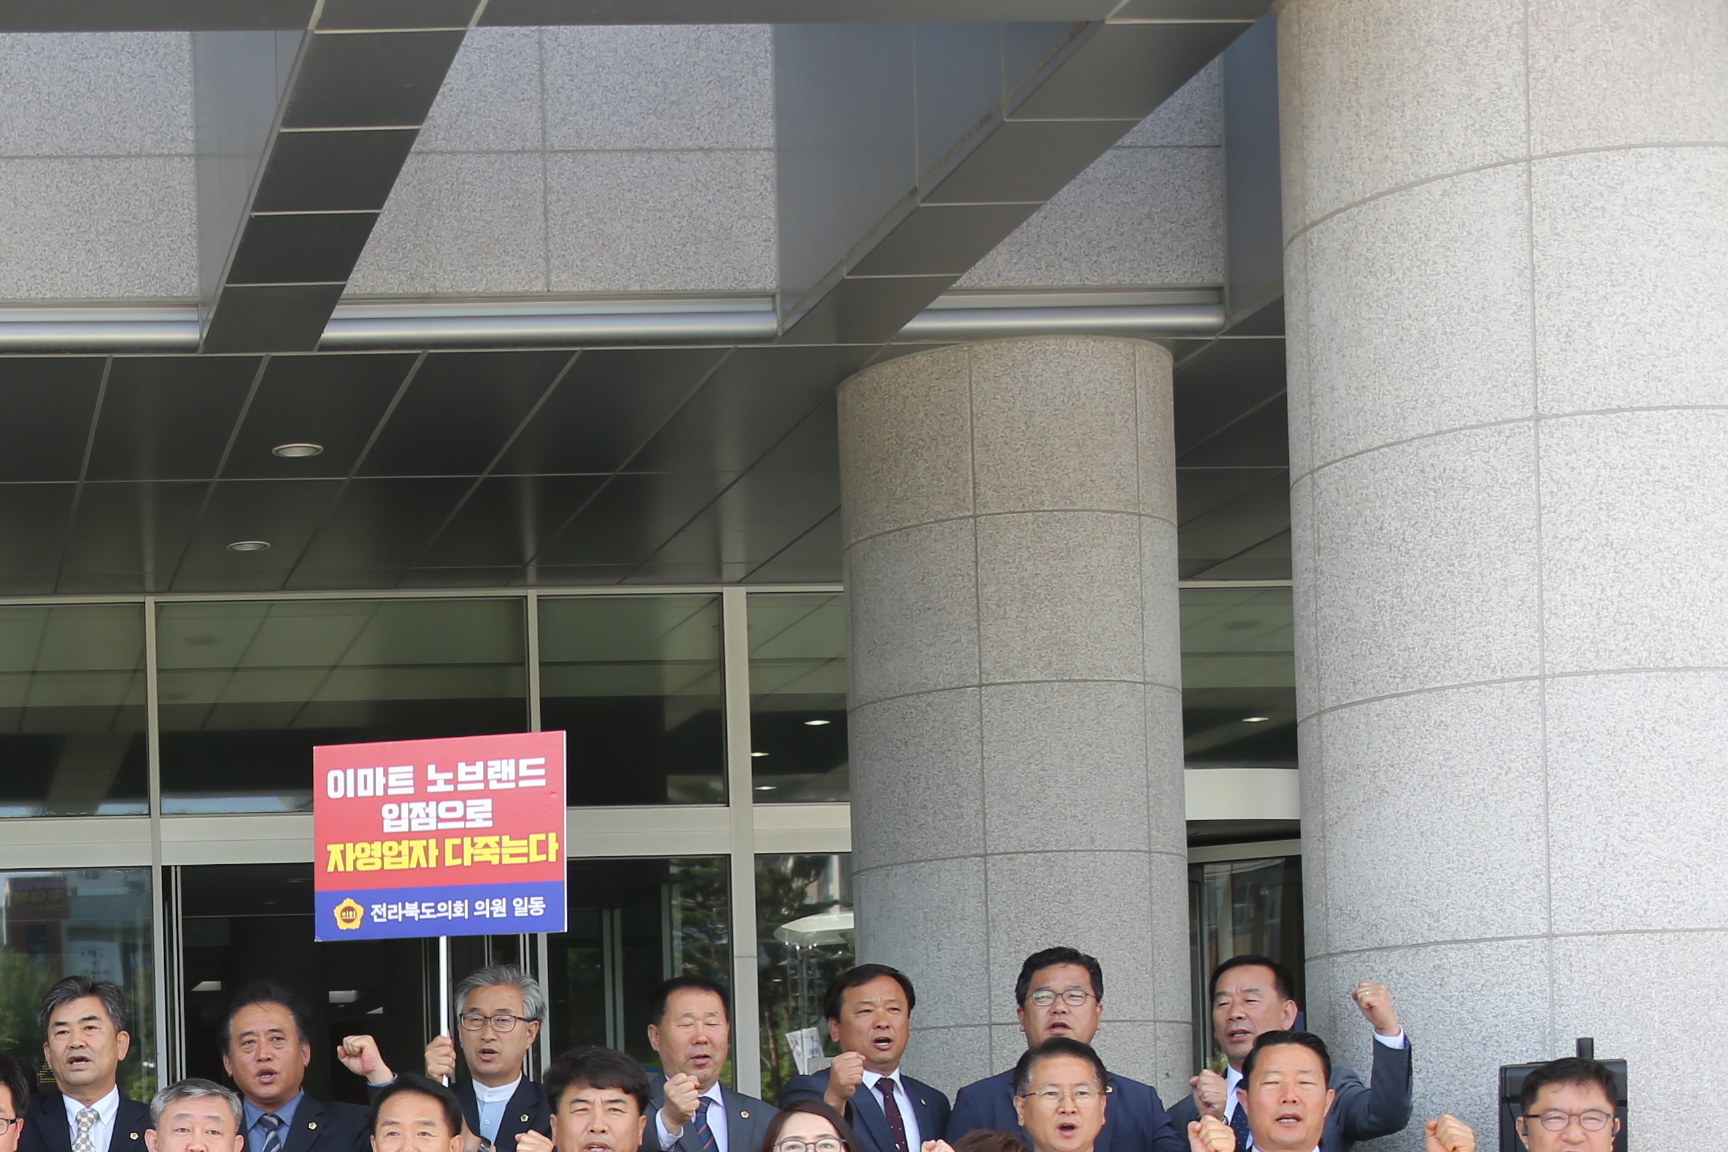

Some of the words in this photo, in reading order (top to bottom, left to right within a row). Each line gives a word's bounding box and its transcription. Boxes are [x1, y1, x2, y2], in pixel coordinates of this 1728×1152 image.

[326, 765, 415, 799] 이마트
[426, 757, 546, 793] 노브랜드
[381, 798, 493, 833] 입점으로
[326, 838, 439, 872] 자영업자
[444, 833, 559, 867] 다죽는다
[341, 910, 356, 920] 의회
[371, 899, 468, 923] 전라북도의회
[474, 898, 507, 918] 의원
[513, 897, 545, 917] 일동
